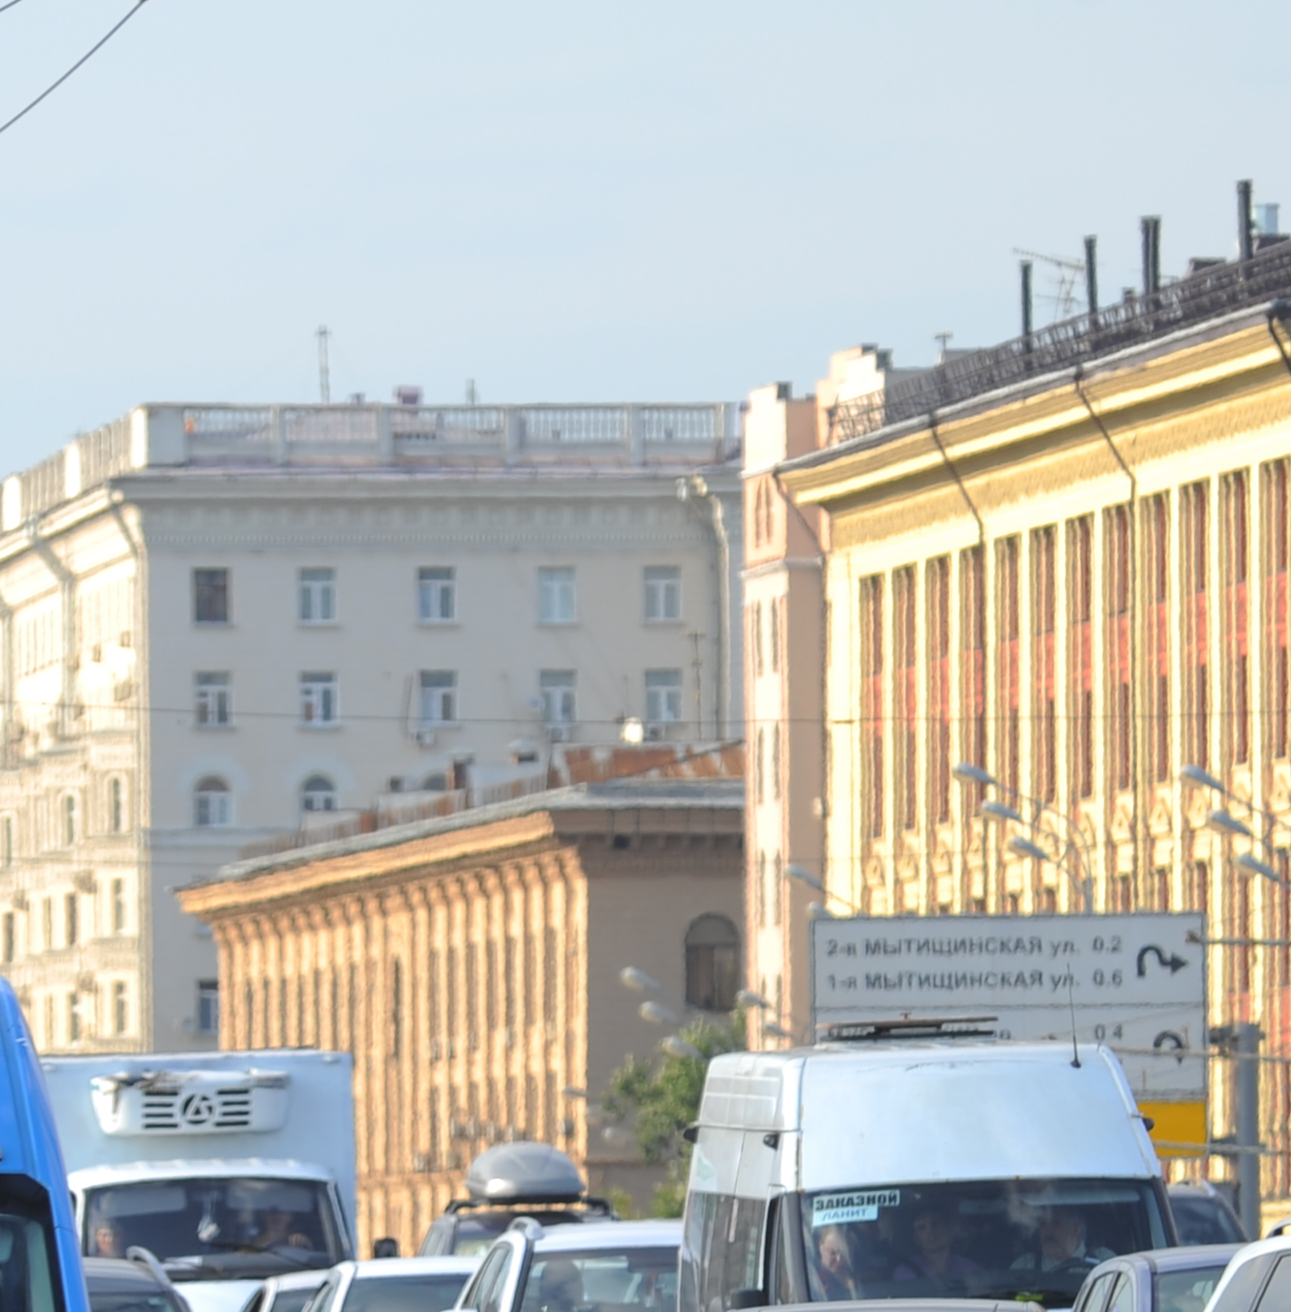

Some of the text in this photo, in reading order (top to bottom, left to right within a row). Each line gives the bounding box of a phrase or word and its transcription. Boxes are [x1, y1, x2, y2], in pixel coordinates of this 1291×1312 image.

[828, 939, 857, 957] 2-я
[865, 937, 1043, 957] МЫТИЩИНСКАЯ
[1050, 940, 1080, 958] ул.
[828, 973, 857, 990] 1-я
[865, 970, 1043, 991] МЫТИЩИНСКАЯ
[815, 1190, 898, 1211] ЗАКАЗНОЙ
